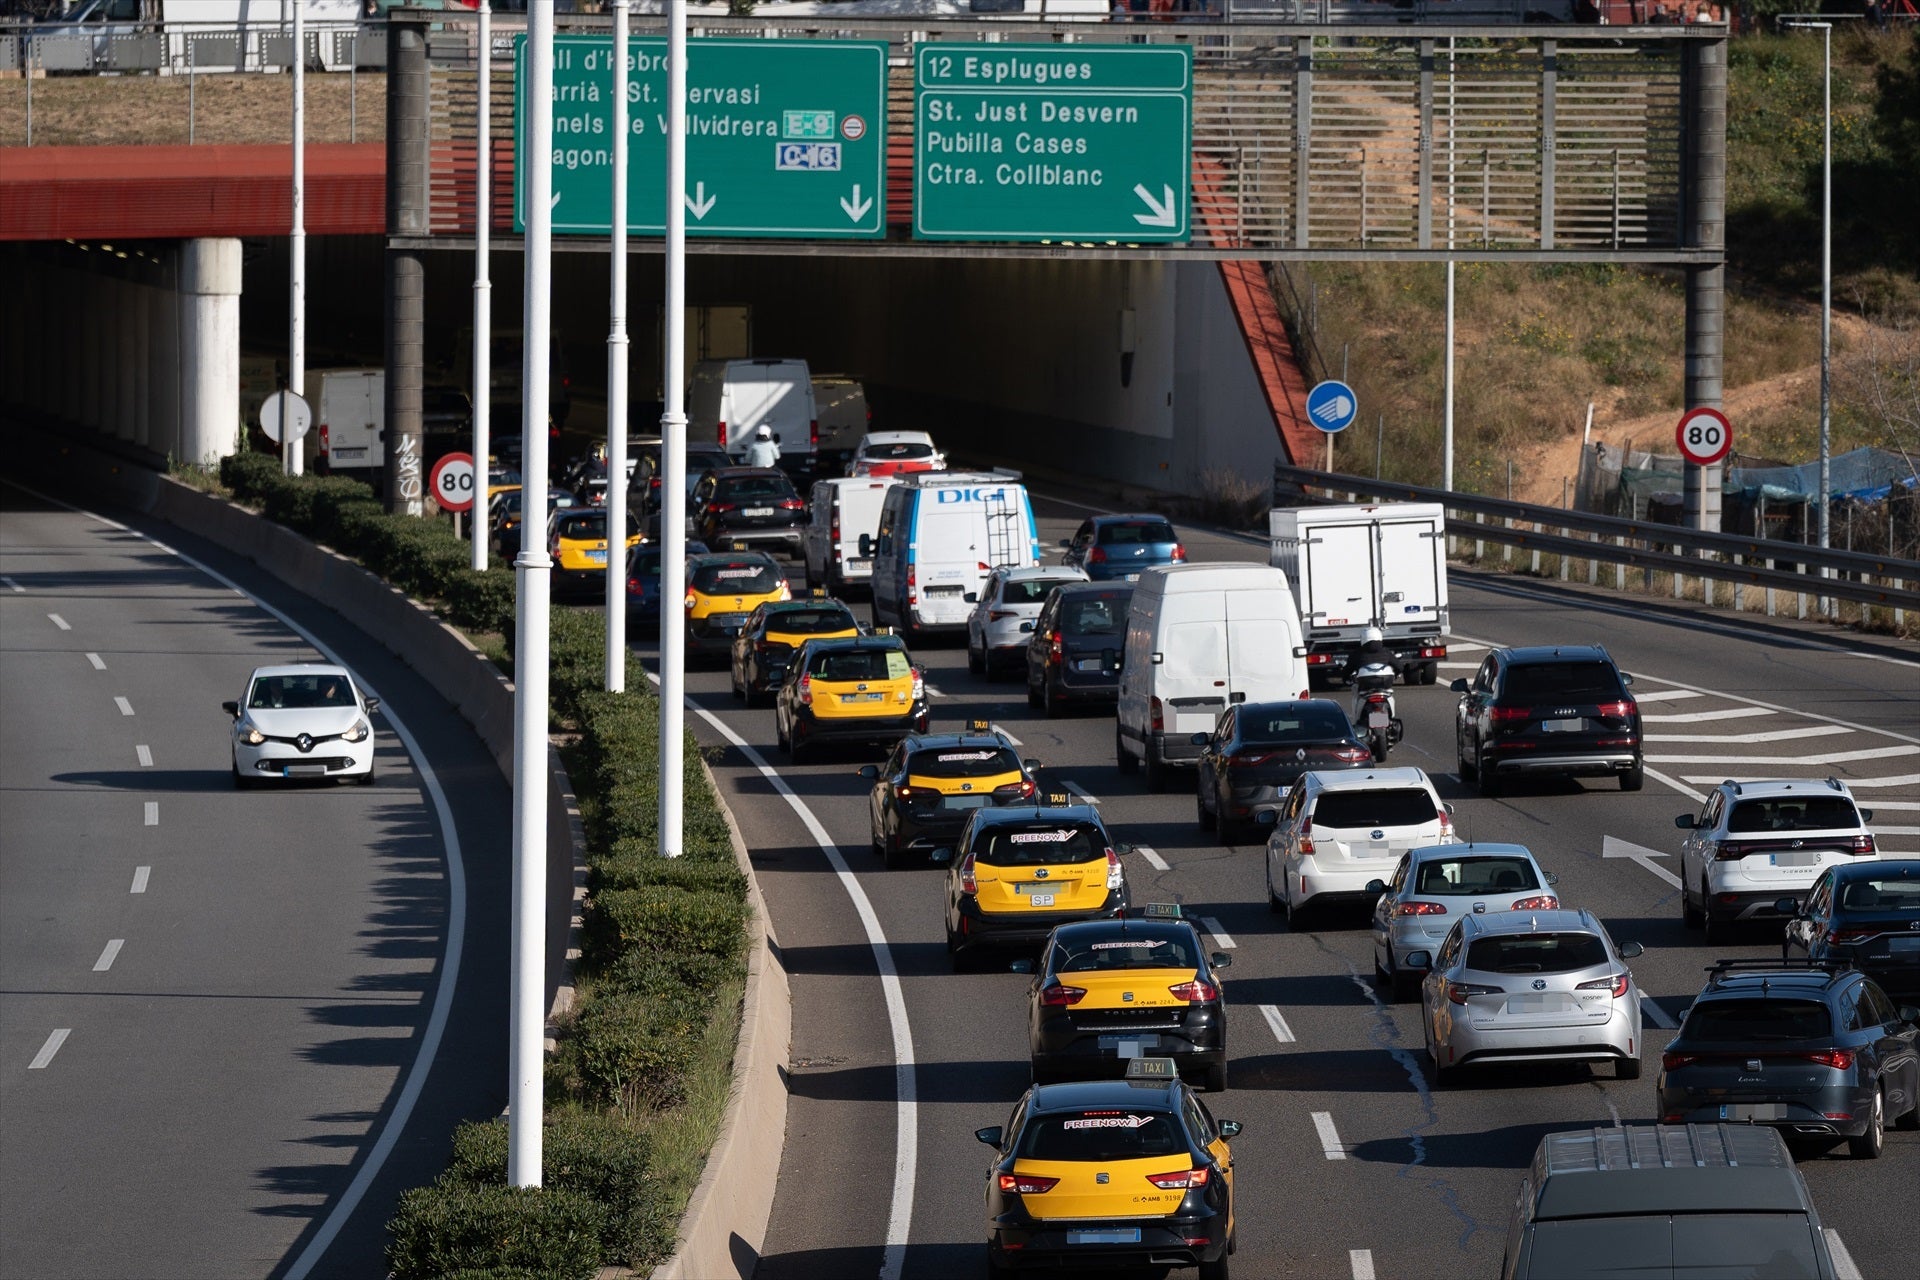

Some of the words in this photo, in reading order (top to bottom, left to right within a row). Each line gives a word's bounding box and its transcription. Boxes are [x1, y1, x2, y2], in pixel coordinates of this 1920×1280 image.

[928, 57, 951, 78] 12
[965, 57, 1092, 83] Esplugues
[552, 81, 600, 102] arrià
[628, 81, 658, 103] St.
[687, 84, 760, 105] ervasi
[928, 99, 962, 122] St.
[975, 101, 1028, 122] Just
[1041, 102, 1139, 123] Desvern
[553, 112, 604, 134] nels
[628, 113, 645, 135] e
[657, 113, 778, 137] Vllvidrera
[787, 114, 829, 135] E-9
[927, 132, 1002, 153] Pubilla
[1015, 133, 1087, 154] Cases
[783, 146, 834, 167] C-16
[927, 163, 984, 184] Ctra.
[996, 164, 1103, 186] Collblanc
[1689, 427, 1720, 445] 80
[443, 473, 473, 491] 80
[973, 721, 988, 729] TAXI
[1050, 794, 1066, 803] TAXI
[1011, 833, 1060, 843] FREENOW
[1033, 895, 1051, 905] SP
[1157, 906, 1173, 915] TAXI
[1092, 942, 1147, 950] FREENOW
[1143, 1062, 1165, 1073] TAXI
[1065, 1119, 1131, 1129] FREENOW
